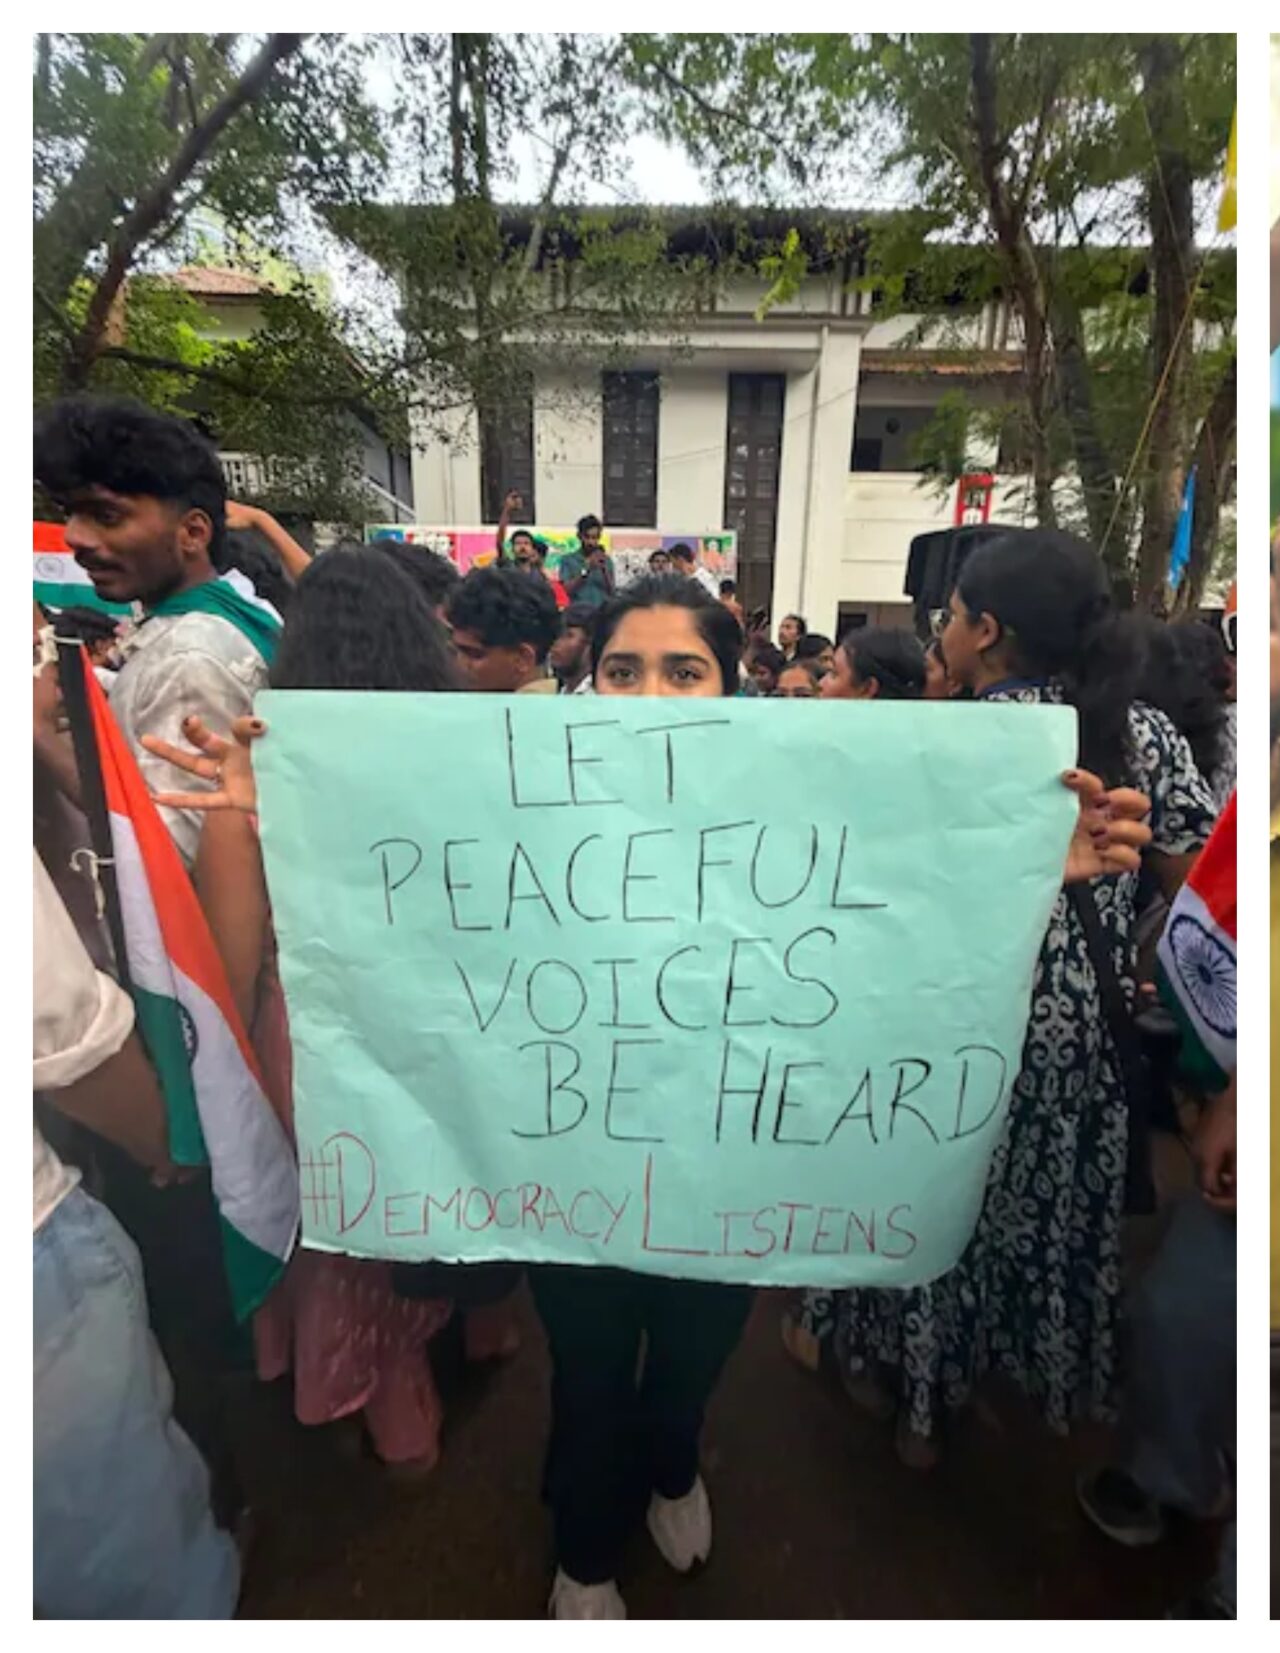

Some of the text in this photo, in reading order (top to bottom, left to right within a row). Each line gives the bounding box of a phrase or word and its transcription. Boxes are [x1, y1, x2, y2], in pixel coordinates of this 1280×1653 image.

[505, 707, 731, 809] LET
[369, 820, 889, 932] PEACEFUL
[455, 926, 839, 1034] VOICES
[510, 1037, 1007, 1146] BE HEARD
